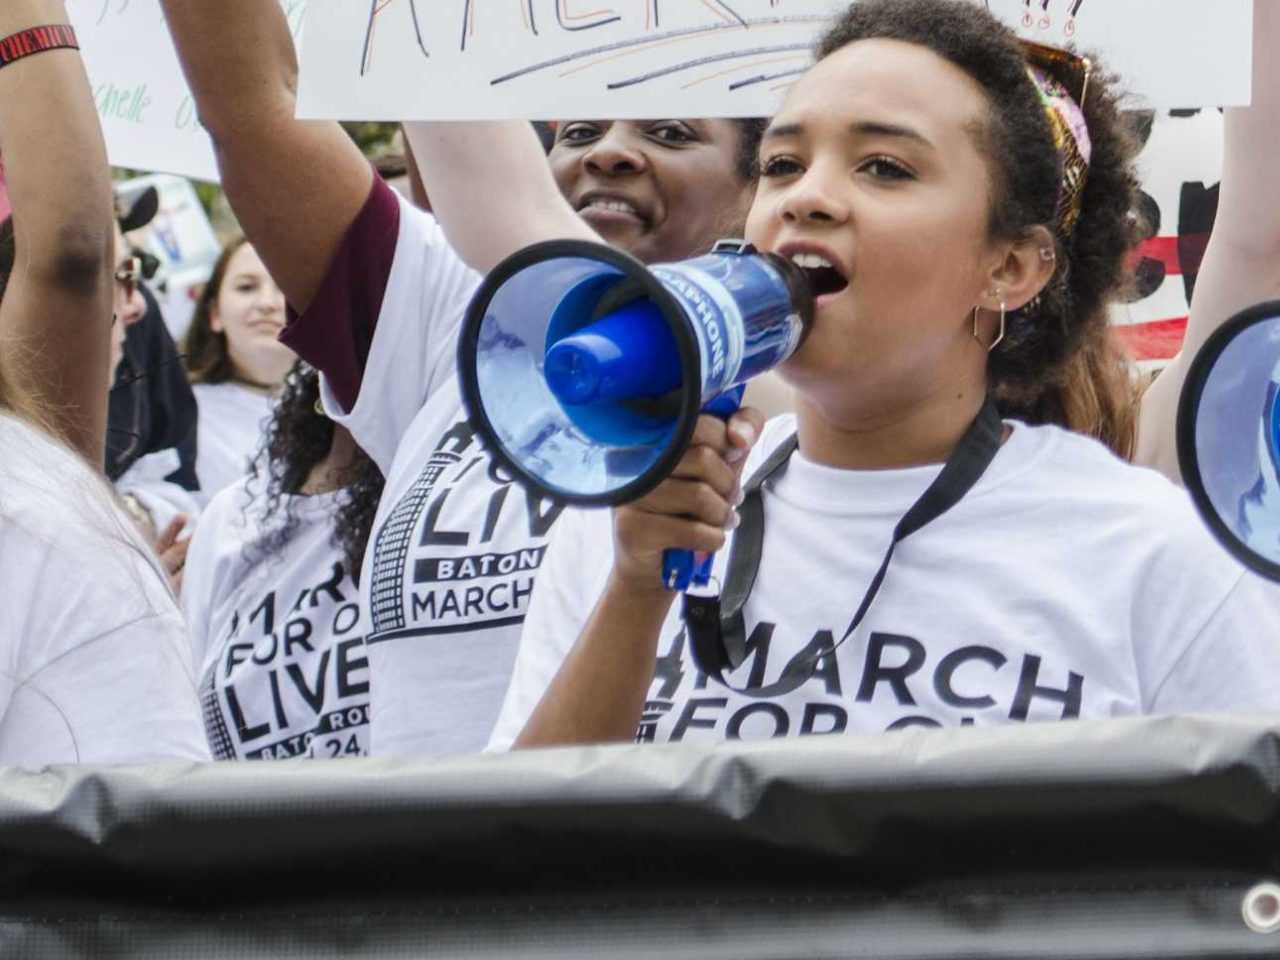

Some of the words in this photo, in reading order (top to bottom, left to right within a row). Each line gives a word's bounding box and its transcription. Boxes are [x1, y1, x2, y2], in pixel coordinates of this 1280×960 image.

[419, 485, 567, 547] LIV
[436, 551, 539, 580] BATON
[333, 602, 360, 635] O
[411, 577, 534, 622] MARCH
[225, 636, 370, 745] LIVE
